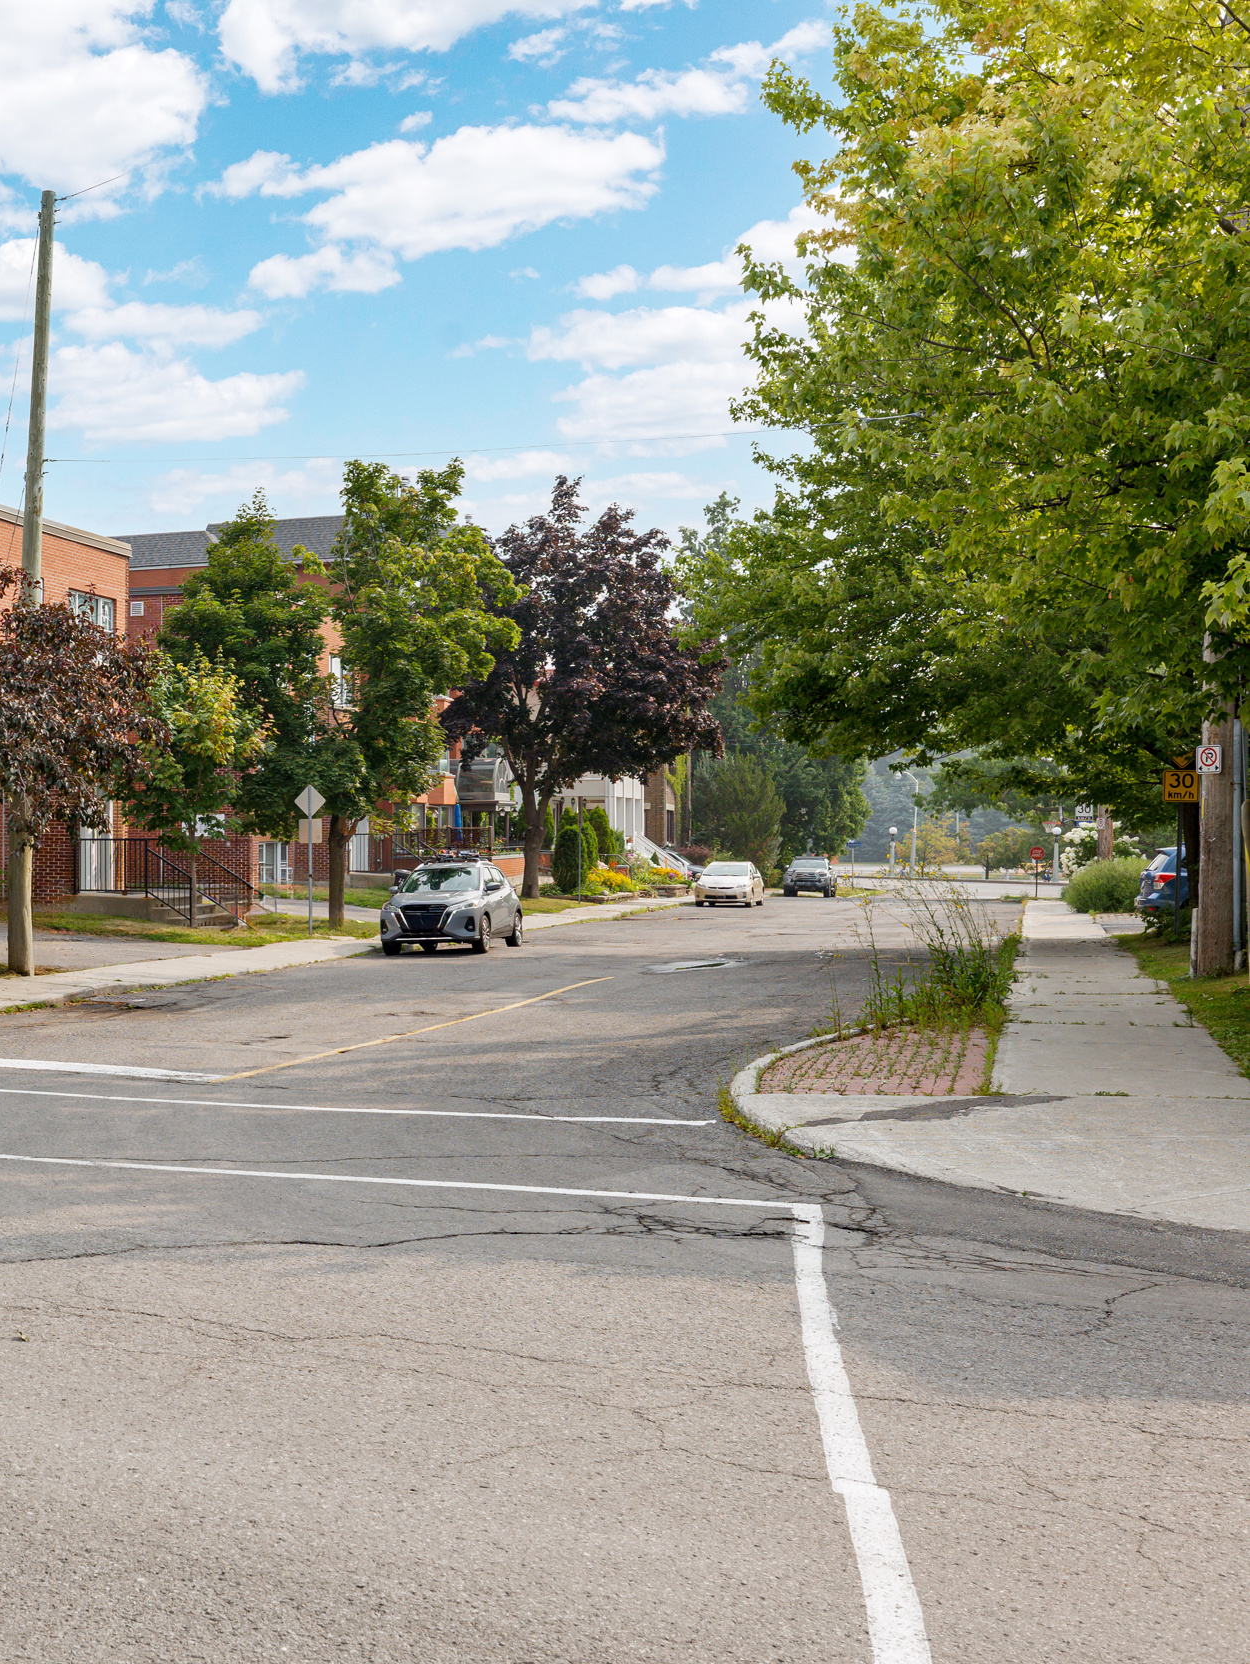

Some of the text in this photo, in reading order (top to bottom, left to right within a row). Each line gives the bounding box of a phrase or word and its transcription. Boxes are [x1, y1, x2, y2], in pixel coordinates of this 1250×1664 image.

[1169, 773, 1194, 789] 30
[1167, 791, 1194, 799] km/h
[1077, 805, 1092, 814] 30
